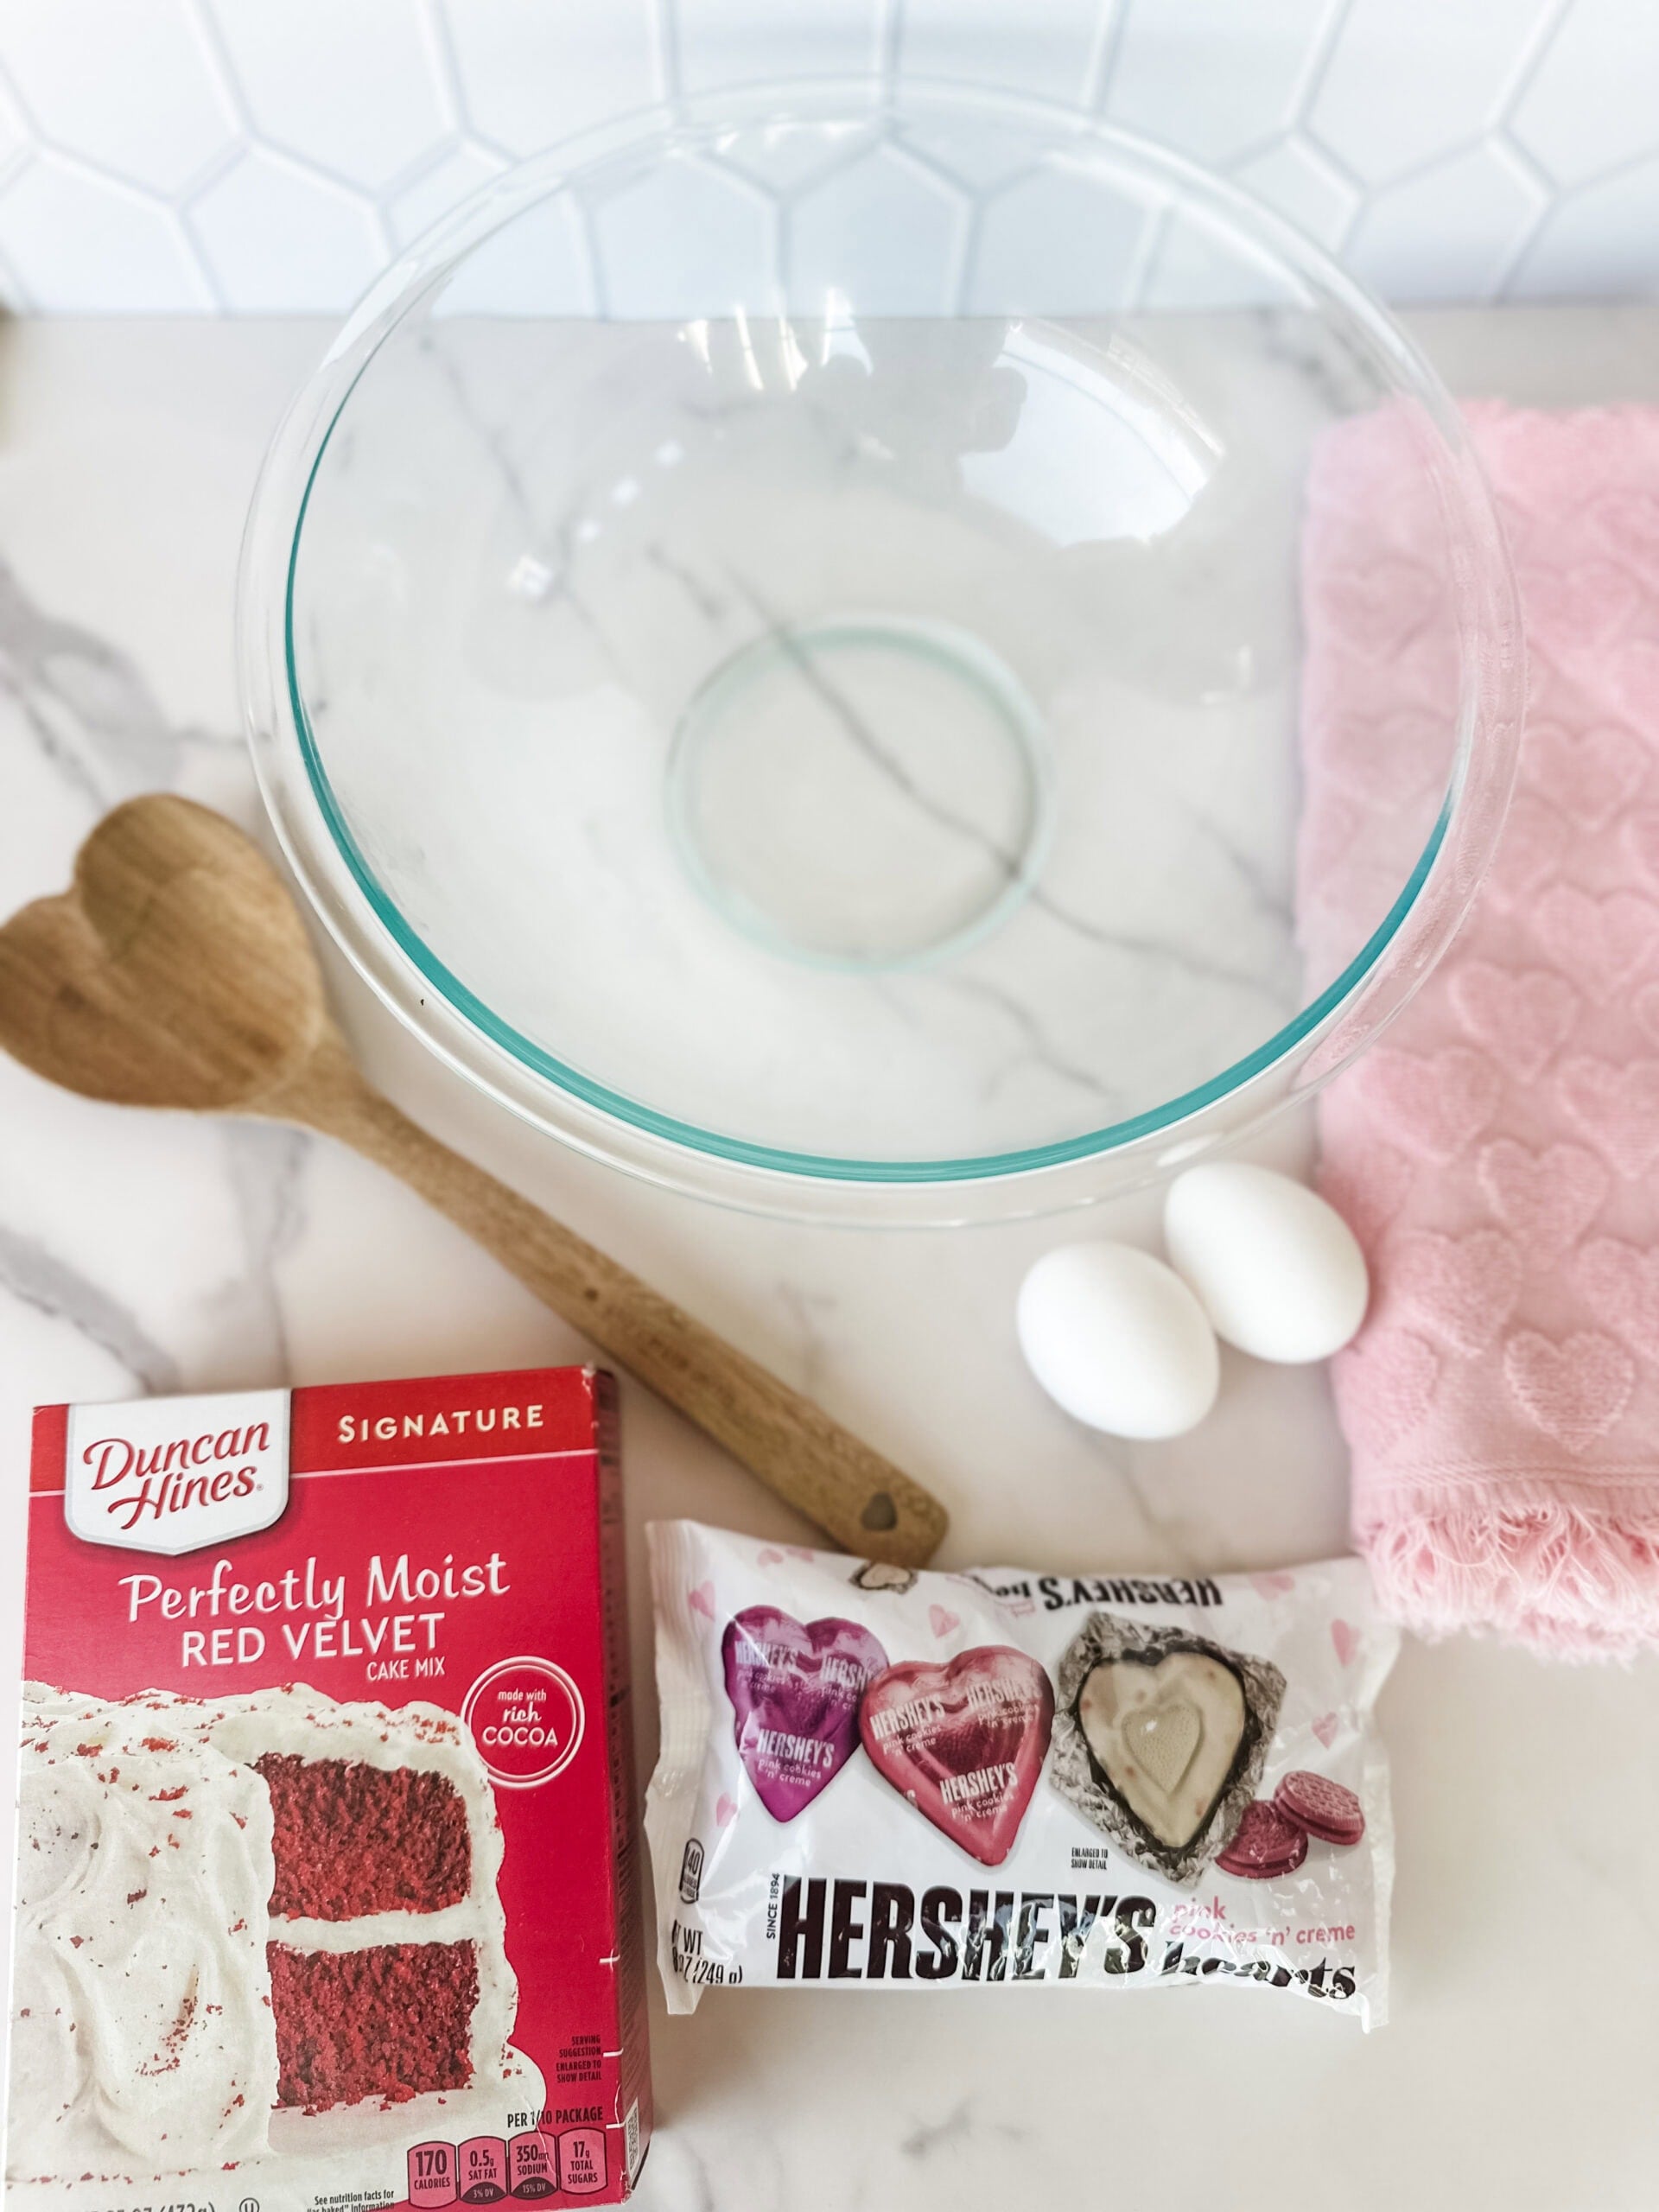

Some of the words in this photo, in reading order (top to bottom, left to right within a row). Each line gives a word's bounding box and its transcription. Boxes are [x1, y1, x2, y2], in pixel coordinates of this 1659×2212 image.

[338, 1405, 543, 1444] SIGNATURE
[83, 1422, 270, 1490] Duncan
[118, 1556, 346, 1623] Perfectly
[366, 1553, 512, 1606] Moist
[181, 1626, 265, 1668] RED
[282, 1612, 445, 1660] VELVET
[367, 1658, 409, 1681] CAKE
[415, 1656, 445, 1678] MIX
[498, 1688, 523, 1700] made
[526, 1688, 546, 1701] with
[503, 1701, 542, 1722] rich
[869, 1694, 945, 1740] HERSHEY'S
[482, 1726, 558, 1746] COCOA
[883, 1738, 904, 1755] pink
[906, 1724, 942, 1741] cookies
[906, 1738, 937, 1752] creme
[756, 1728, 835, 1768] HERSHEY'S
[758, 1758, 780, 1771] pink
[784, 1764, 821, 1779] cookies
[779, 1774, 811, 1787] creme
[939, 1762, 1018, 1804] HERSHEY'S
[950, 1800, 974, 1819] pink
[976, 1803, 1007, 1818] creme
[1071, 1847, 1099, 1858] ENLARGED
[1071, 1859, 1087, 1868] SHOW
[1089, 1859, 1107, 1870] DETAIL
[770, 1873, 780, 1899] 1894
[1173, 1896, 1226, 1922] pink
[766, 1904, 778, 1940] SINCE
[777, 1874, 1156, 1981] HERSHEY'S
[683, 1927, 703, 1955] WT
[1169, 1923, 1257, 1942] cookies
[1296, 1923, 1355, 1944] creme
[571, 2035, 601, 2045] SERVING
[559, 2046, 601, 2058] SUGGESTION
[556, 2060, 591, 2072] ENLARGED
[556, 2074, 577, 2083] SHOW
[578, 2072, 601, 2082] DETAIL
[507, 2113, 528, 2128] PER
[556, 2107, 603, 2124] PACKAGE
[416, 2149, 448, 2177] 170
[518, 2163, 548, 2176] SODIUM
[570, 2160, 593, 2171] TOTAL
[414, 2177, 450, 2190] CALORIES
[468, 2170, 482, 2181] SAT
[484, 2168, 497, 2179] FAT
[568, 2172, 598, 2184] SUGARS
[315, 2196, 327, 2205] See
[330, 2192, 362, 2204] nutrition
[365, 2190, 382, 2201] facts
[384, 2189, 394, 2198] for
[473, 2189, 483, 2198] 3%
[485, 2188, 494, 2197] DV
[522, 2184, 536, 2193] 15%
[537, 2183, 546, 2191] DV
